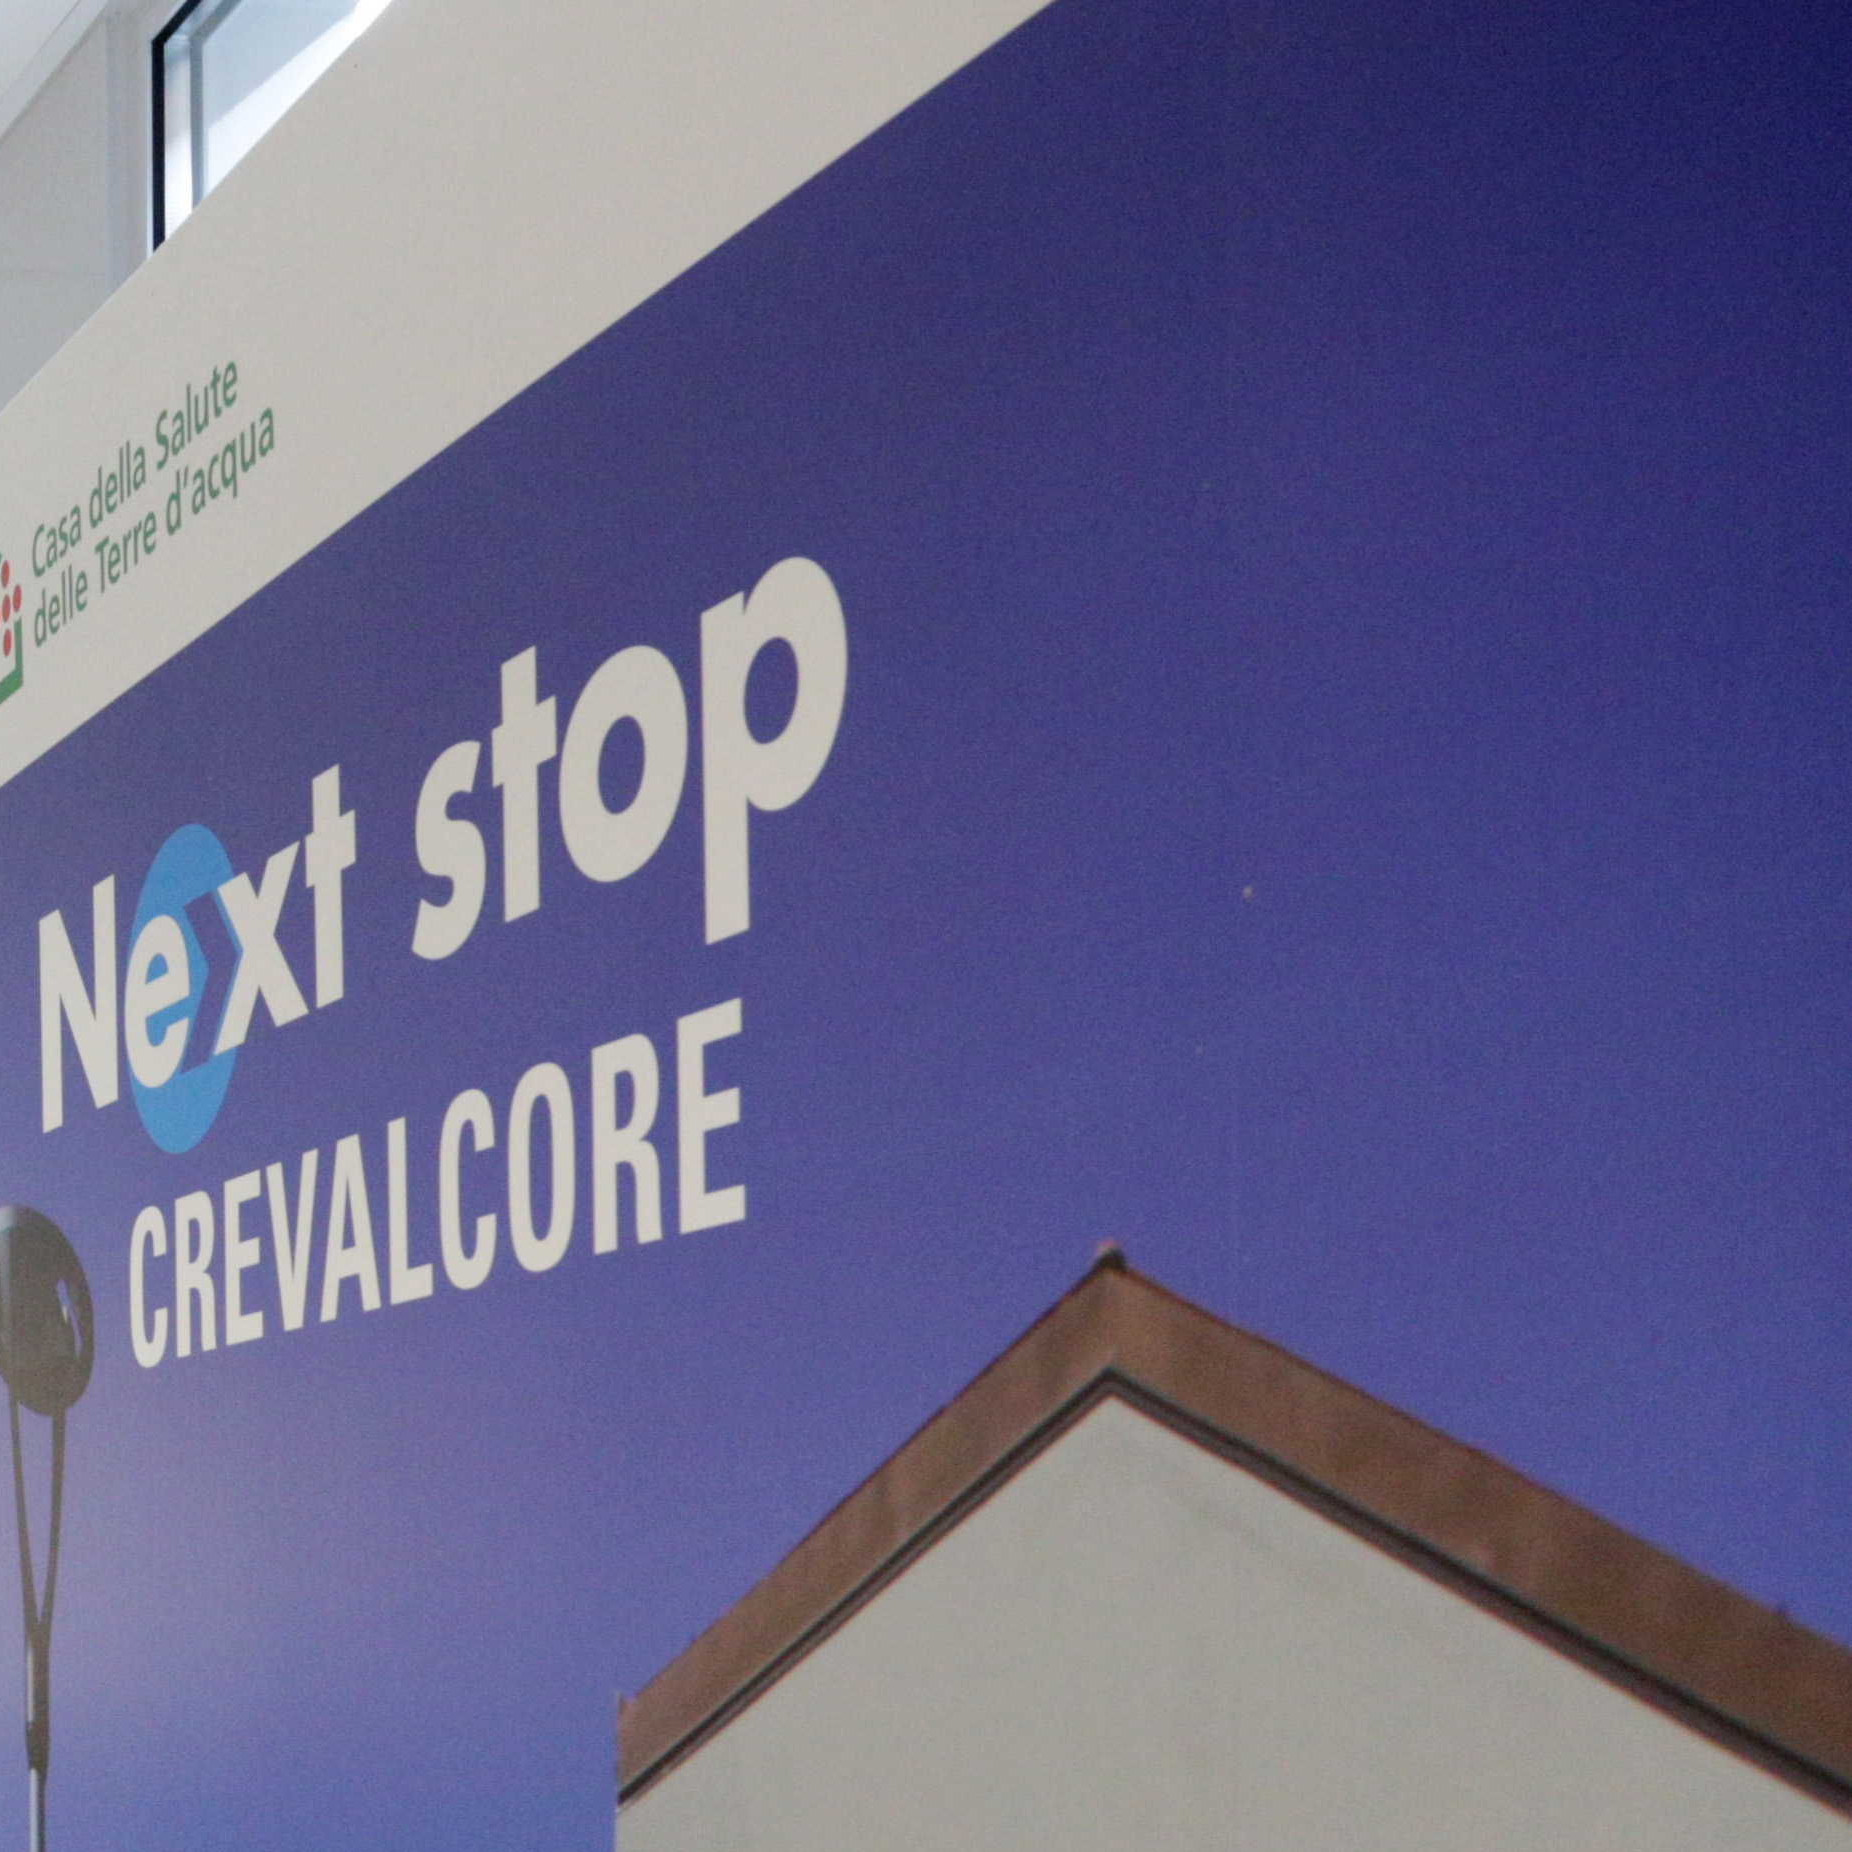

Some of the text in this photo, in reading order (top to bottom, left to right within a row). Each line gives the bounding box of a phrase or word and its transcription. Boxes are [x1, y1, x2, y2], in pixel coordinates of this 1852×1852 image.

[32, 360, 238, 579] Casa della Salute
[35, 407, 275, 648] delle Terre d'acqua
[38, 555, 849, 1134] Next stop
[128, 996, 747, 1369] CREVALCORE
